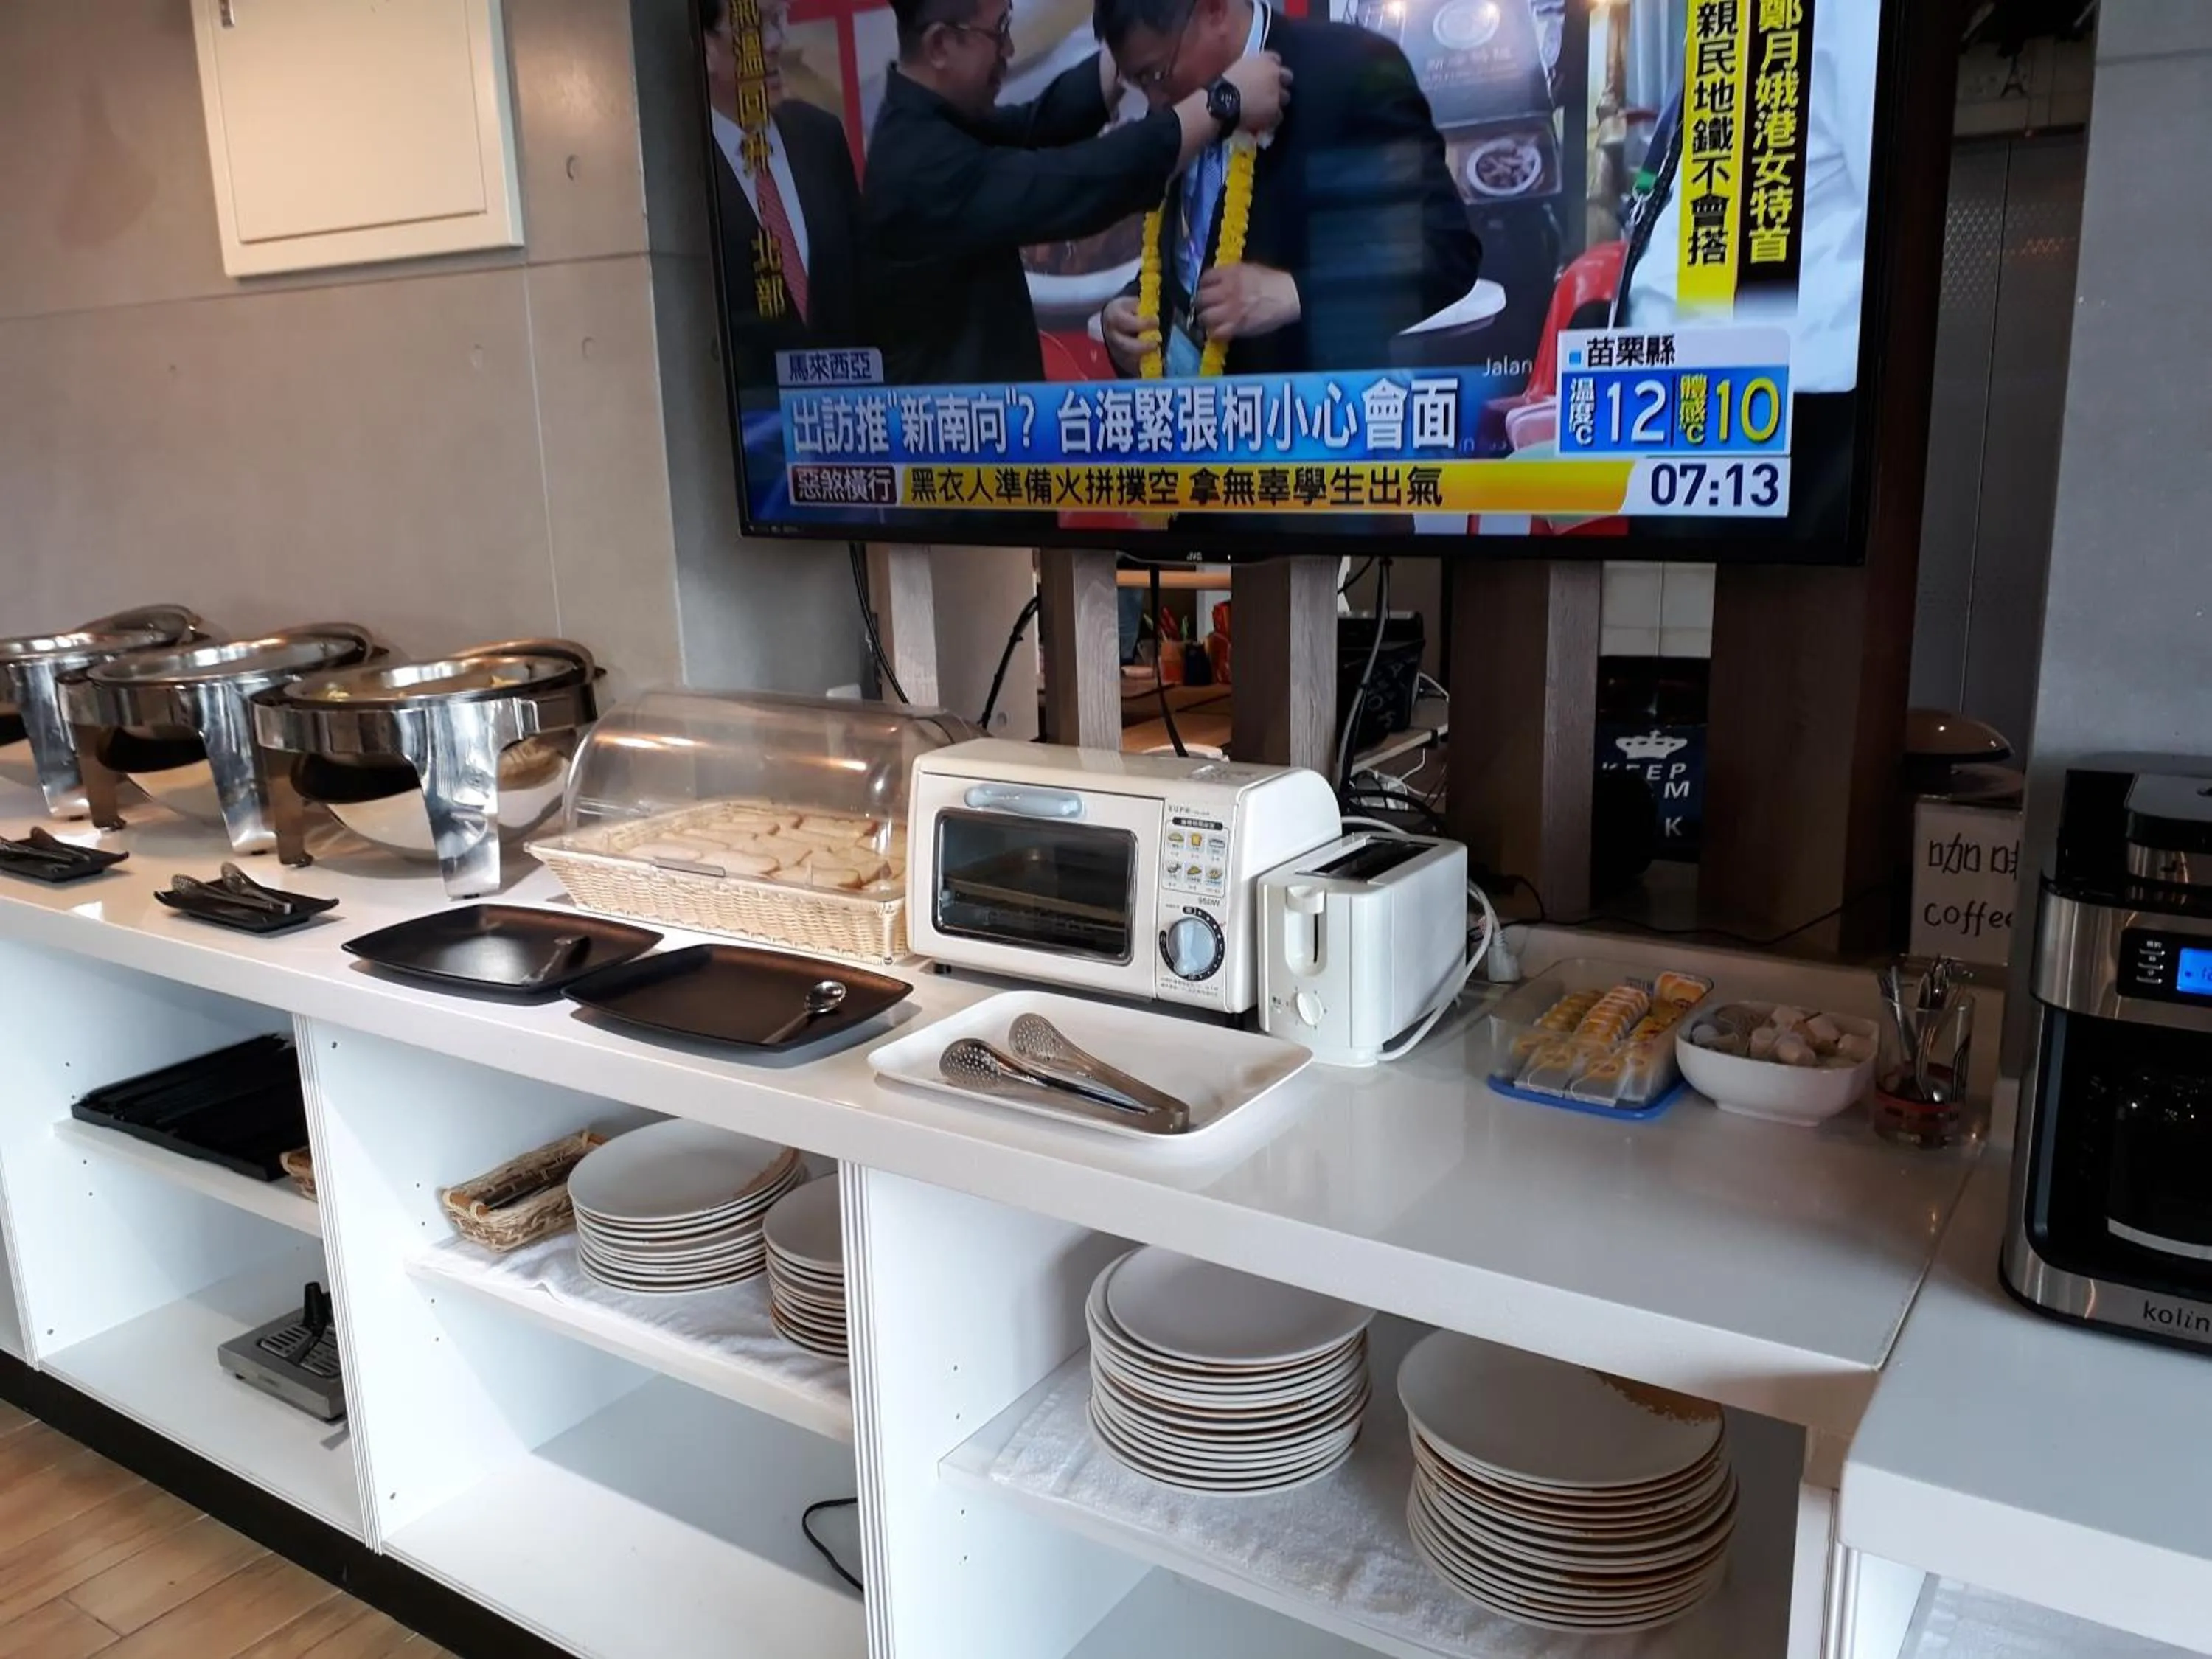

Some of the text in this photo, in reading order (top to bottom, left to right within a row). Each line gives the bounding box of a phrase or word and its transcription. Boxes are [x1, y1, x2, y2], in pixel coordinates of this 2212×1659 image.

[789, 351, 872, 381] 馬來西亞
[1482, 355, 1533, 377] Jalan
[1587, 335, 1675, 367] 苗栗縣
[1057, 377, 1458, 453] 台海緊張柯小心會面
[1607, 380, 1666, 442] 12
[1717, 378, 1779, 442] 10
[911, 465, 1443, 507] 黑衣人準備火拼撲空 拿無辜學生出氣
[1651, 463, 1779, 507] 07:13
[2143, 1299, 2210, 1333] kolin
